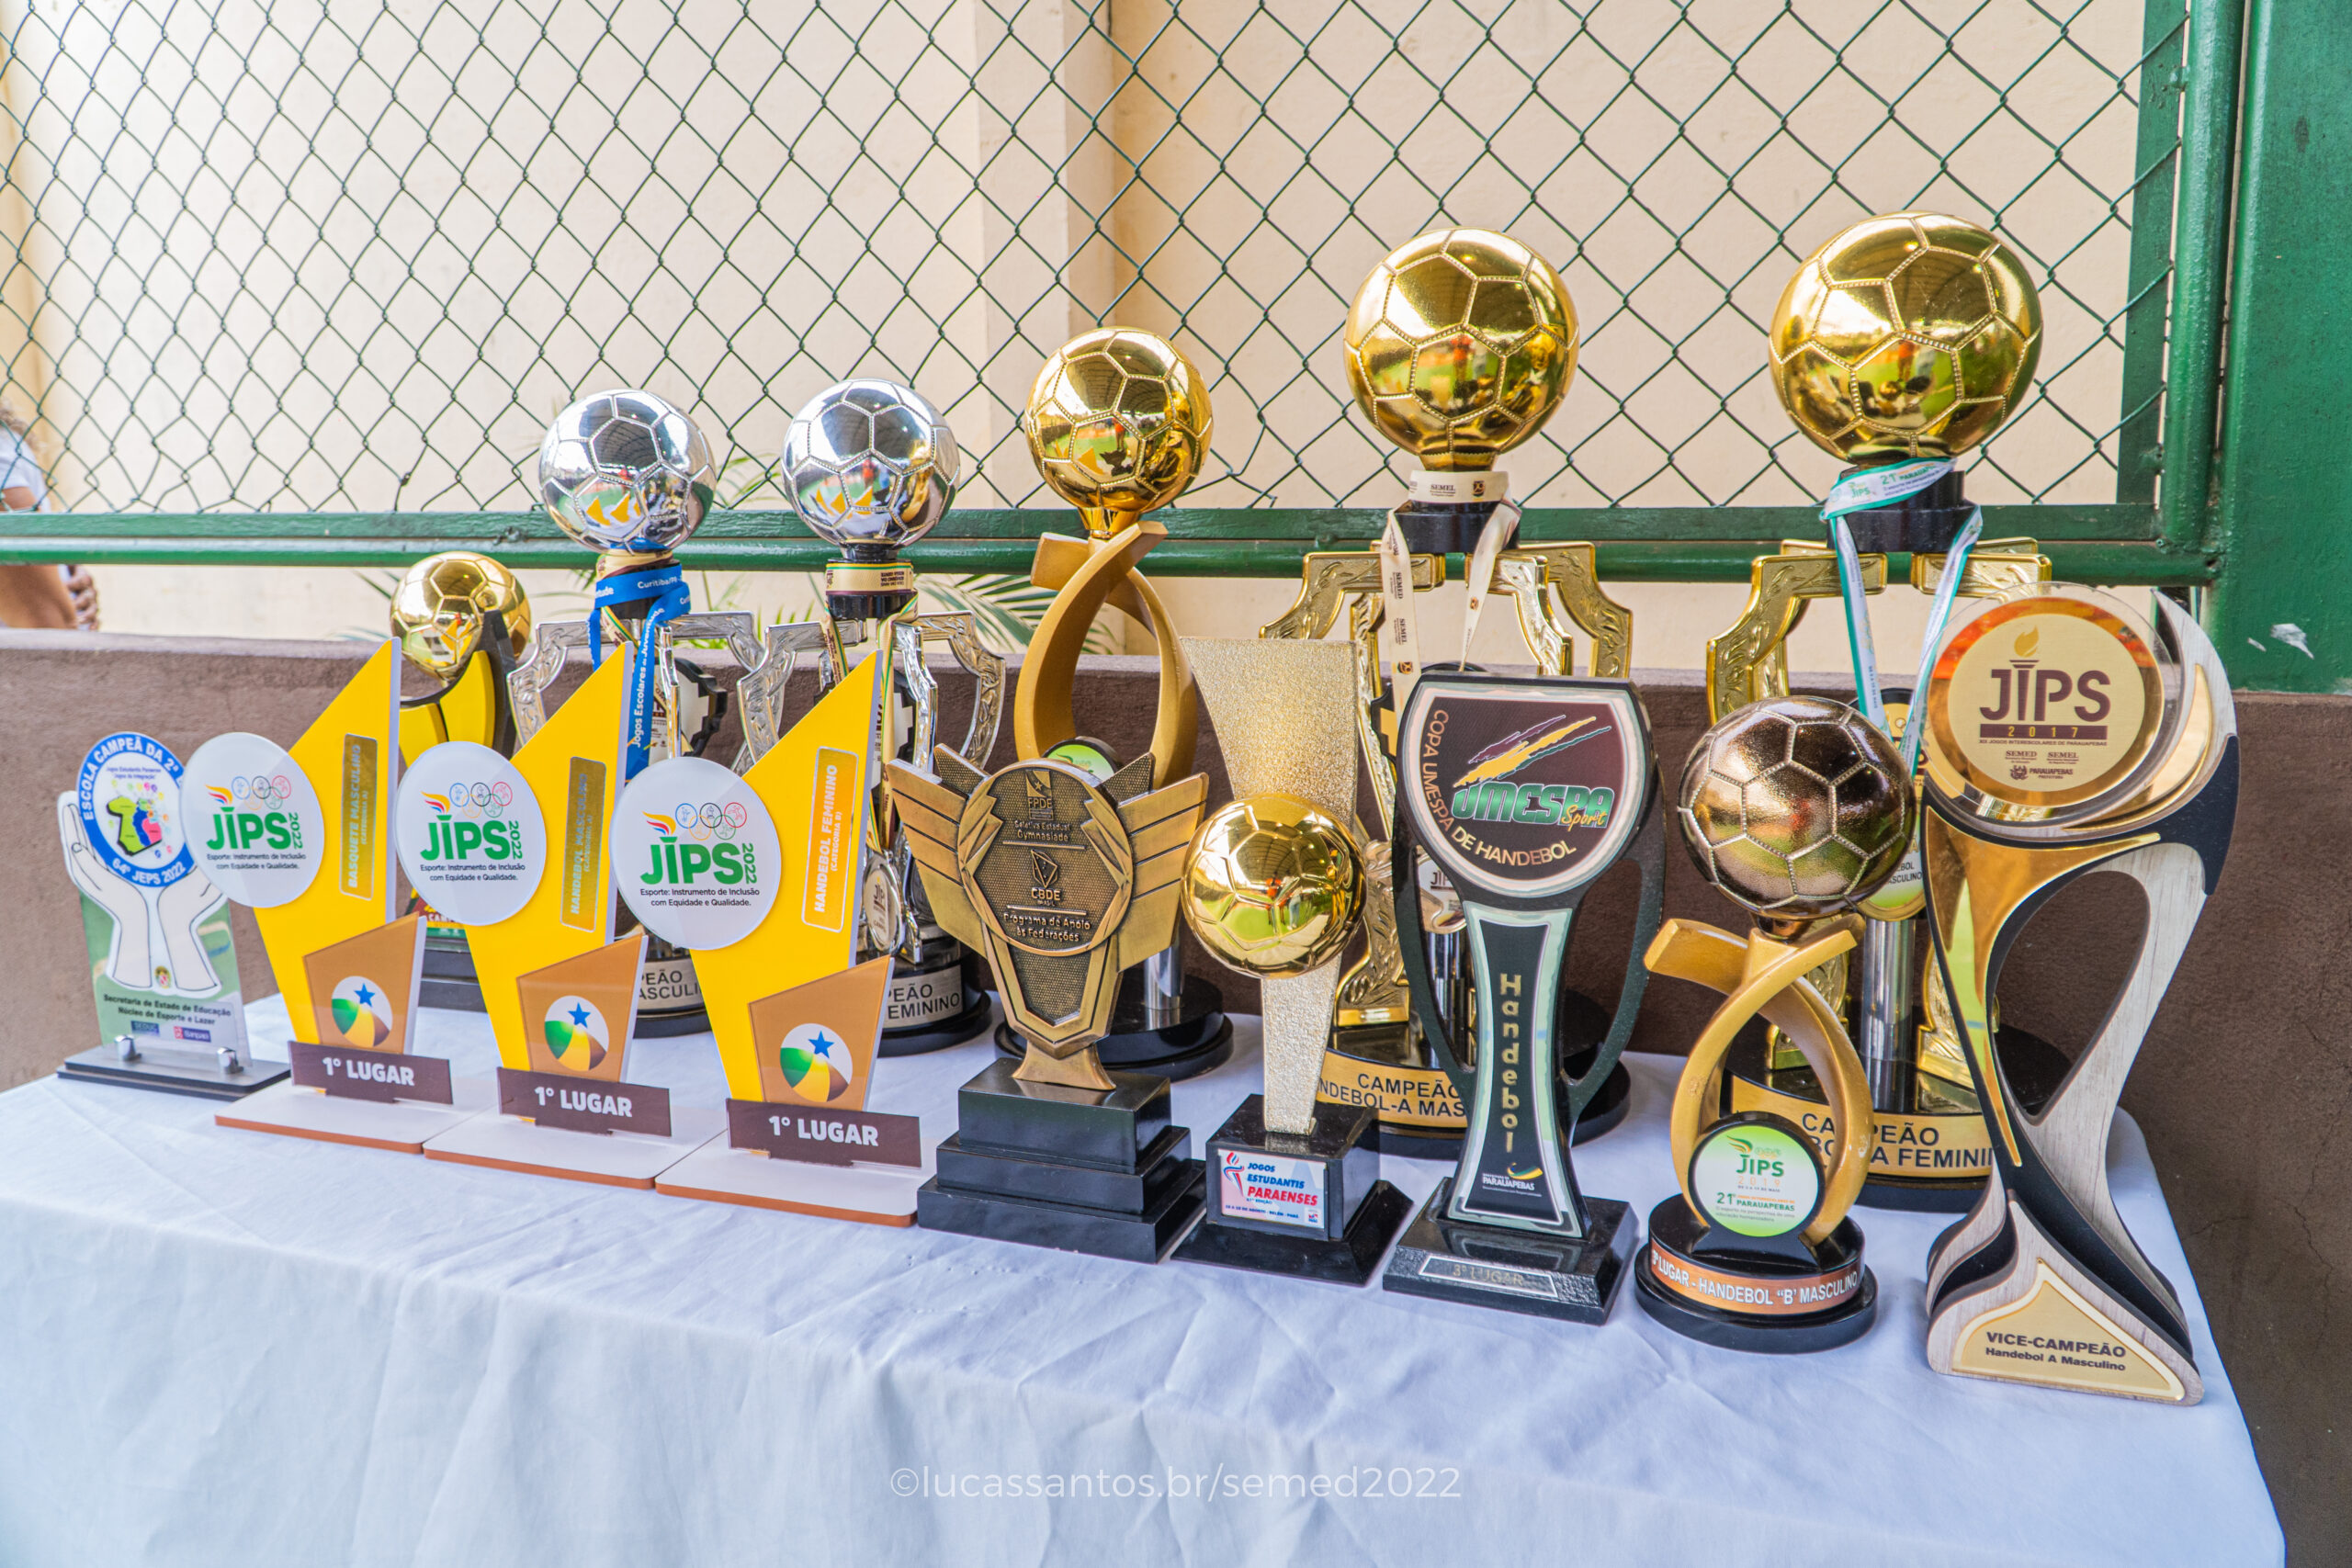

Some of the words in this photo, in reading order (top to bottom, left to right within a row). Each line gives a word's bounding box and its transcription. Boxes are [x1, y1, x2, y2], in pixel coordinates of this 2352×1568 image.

[634, 671, 648, 716] Escolares
[1979, 661, 2111, 722] JIPS
[631, 716, 644, 748] Jogos
[1423, 709, 1450, 759] COPA
[2008, 726, 2078, 739] 2017
[80, 761, 99, 821] ESCOLA
[145, 741, 164, 762] DA
[351, 744, 361, 819] MASCULINO
[575, 773, 588, 846] MASCULINO
[821, 764, 838, 834] FEMININO
[1028, 797, 1053, 808] FPDE
[1422, 761, 1456, 832] UMESPA
[1451, 781, 1615, 829] UMESPA
[206, 807, 292, 851] JIPS
[288, 812, 303, 849] 2022
[1561, 805, 1608, 832] Sport
[420, 815, 511, 861] JIPS
[508, 819, 524, 860] 2022
[831, 822, 842, 873] (CATEGORIA
[1017, 829, 1069, 841] Gymnasiade
[1451, 825, 1476, 851] DE
[348, 821, 360, 888] BASQUETE
[639, 836, 744, 886] JIPS
[742, 843, 757, 886] 2022
[1475, 840, 1577, 867] HANDEBOL
[132, 871, 162, 886] JEPS
[161, 861, 186, 884] 2022
[421, 863, 447, 872] Esporte:
[445, 874, 476, 882] Equidade
[814, 836, 831, 913] HANDEBOL
[570, 849, 584, 915] HANDEBOL
[639, 888, 671, 897] Esporte:
[671, 887, 717, 897] Instrumento
[717, 887, 728, 897] de
[729, 887, 761, 897] Inclusão
[1031, 887, 1061, 900] CBDE
[668, 898, 704, 908] Equidade
[711, 898, 752, 908] Qualidade.
[1003, 912, 1047, 926] Programa
[1049, 917, 1060, 927] de
[1063, 917, 1091, 930] Apoio
[1027, 927, 1080, 942] Federações
[641, 968, 683, 985] EÃO
[103, 994, 141, 1007] Secretaria
[143, 998, 153, 1007] de
[154, 999, 181, 1011] Estado
[182, 1003, 191, 1012] de
[193, 1005, 232, 1018] Educação
[888, 983, 933, 1003] EÃO
[145, 1008, 154, 1018] de
[156, 1010, 186, 1022] Esporte
[194, 1016, 216, 1025] Lazer
[345, 1059, 415, 1087] LUGAR
[1499, 972, 1522, 1154] Handebol
[560, 1089, 633, 1118] LUGAR
[797, 1118, 879, 1146] LUGAR
[1248, 1163, 1275, 1172] JOGOS
[1736, 1154, 1784, 1178] JIPS
[1248, 1173, 1306, 1189] ESTUDANTIS
[1482, 1176, 1535, 1190] PARAUAPEBAS
[1248, 1186, 1317, 1206] PARAENSES
[1736, 1200, 1795, 1211] PARAUAPEBAS
[1470, 1266, 1525, 1287] LUGAR
[1659, 1257, 1690, 1288] LUGAR
[1698, 1277, 1773, 1304] HANDEBOL
[1799, 1271, 1858, 1304] MASCULINO
[1986, 1332, 2126, 1358] VICE-CAMPEÃO
[1985, 1347, 2043, 1363] Handebol
[2047, 1353, 2058, 1364] A
[2061, 1356, 2126, 1372] Masculino
